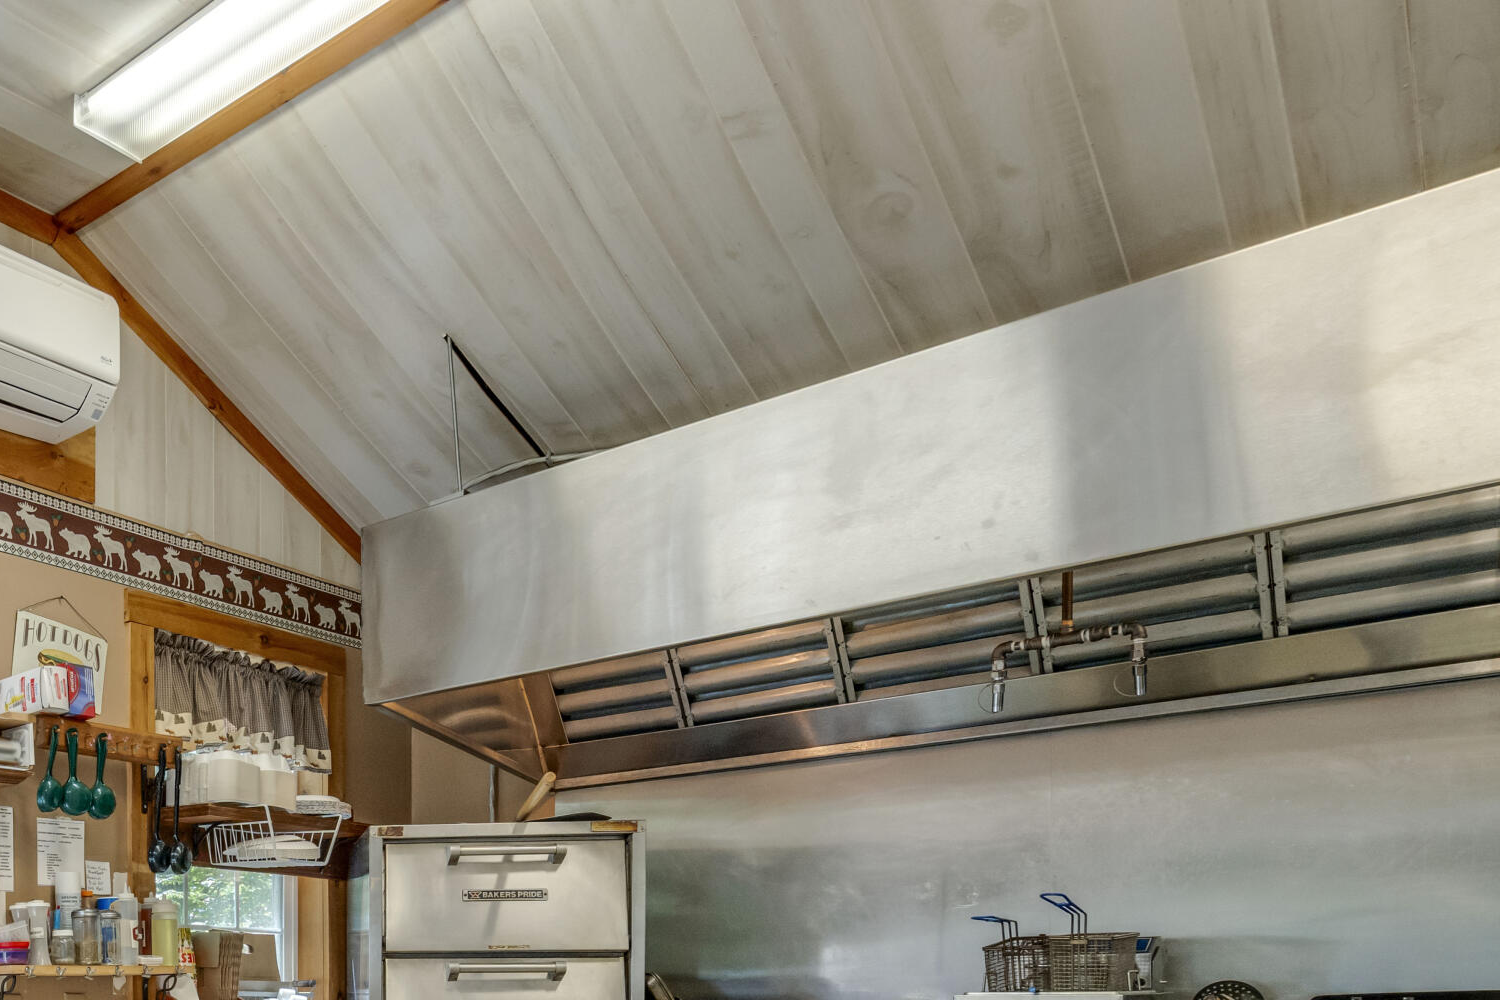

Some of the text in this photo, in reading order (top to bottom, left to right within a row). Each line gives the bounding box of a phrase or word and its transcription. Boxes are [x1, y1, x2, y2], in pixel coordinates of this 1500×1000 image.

[22, 618, 101, 673] HOT DOGS
[517, 890, 542, 898] PRIDE
